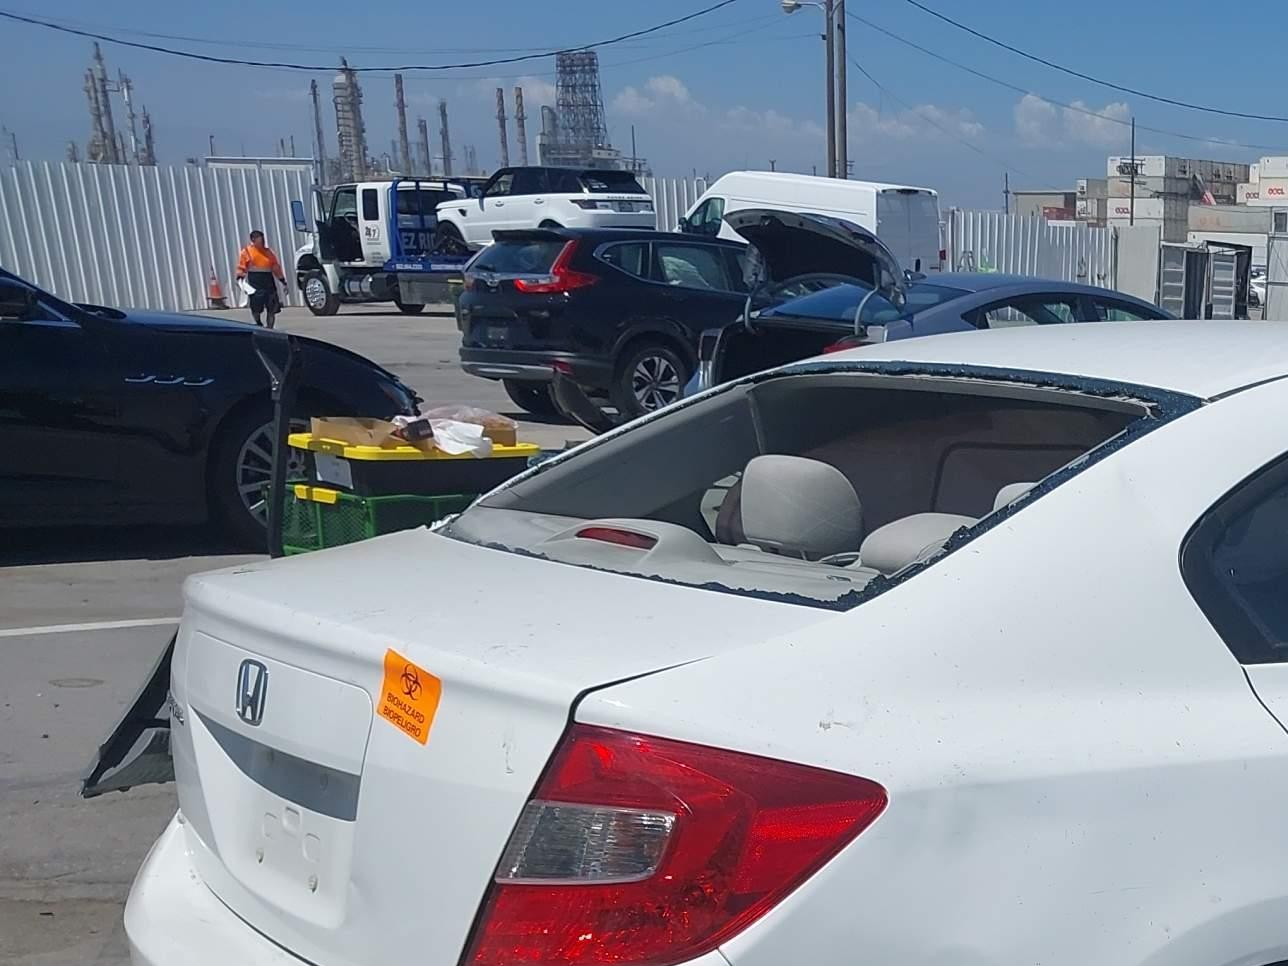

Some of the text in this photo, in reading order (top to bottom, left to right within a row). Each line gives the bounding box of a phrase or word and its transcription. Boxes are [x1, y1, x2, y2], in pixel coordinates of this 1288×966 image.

[1268, 187, 1285, 195] OOCL
[383, 705, 422, 737] BIOPELIGRO
[386, 692, 425, 724] BIOHAZARD
